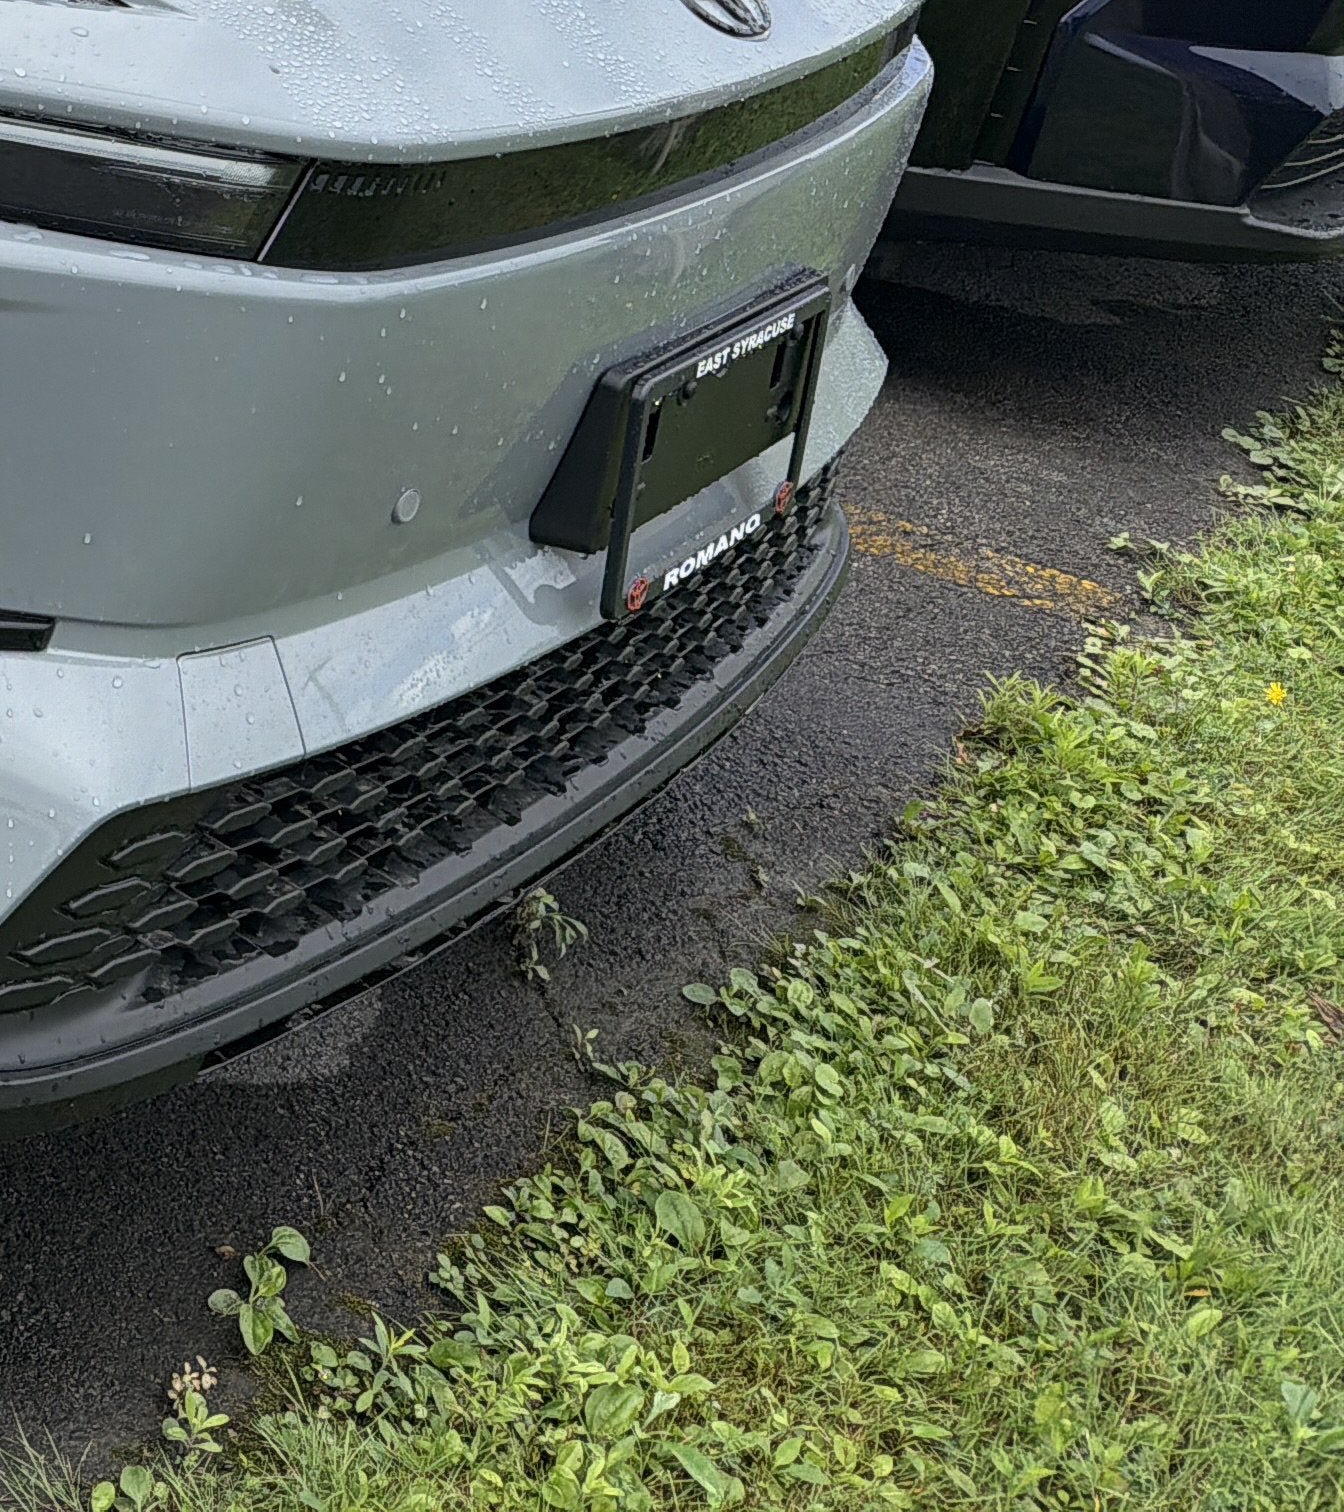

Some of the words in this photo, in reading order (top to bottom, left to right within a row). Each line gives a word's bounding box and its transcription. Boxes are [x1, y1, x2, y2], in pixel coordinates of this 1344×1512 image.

[695, 347, 731, 379] EAST
[732, 312, 796, 360] SYRACUSE
[663, 513, 761, 591] ROMANO
